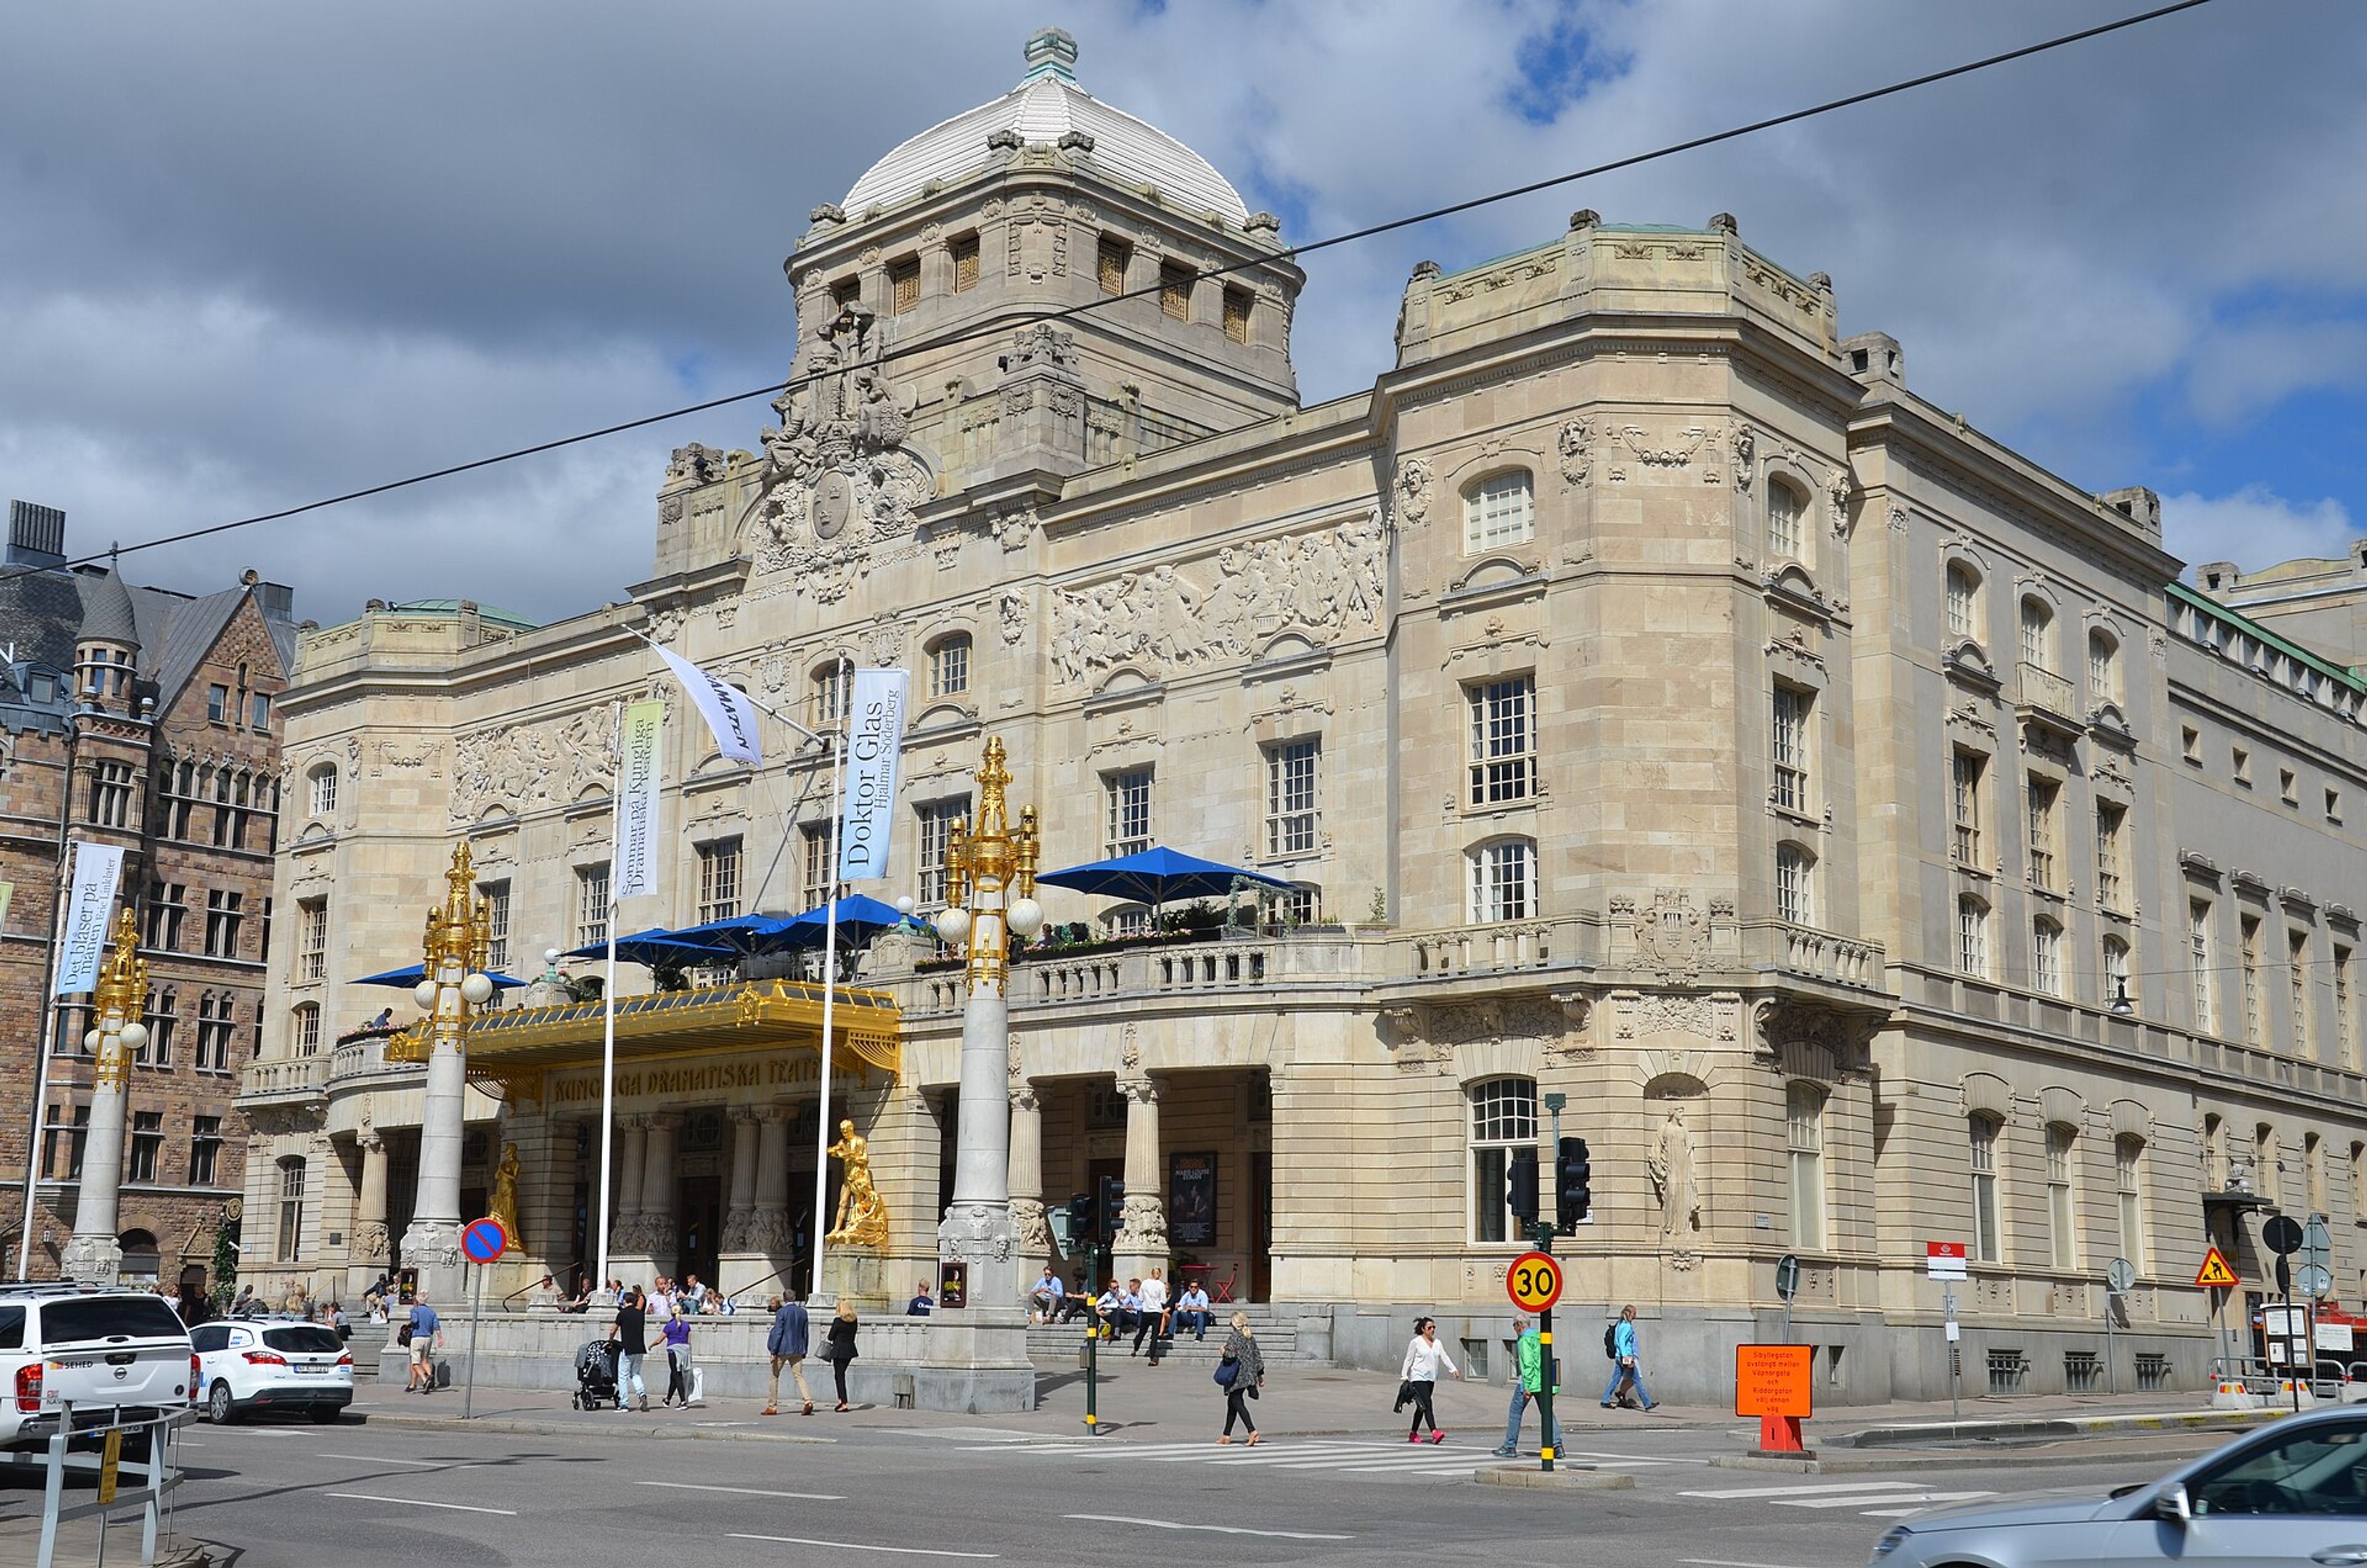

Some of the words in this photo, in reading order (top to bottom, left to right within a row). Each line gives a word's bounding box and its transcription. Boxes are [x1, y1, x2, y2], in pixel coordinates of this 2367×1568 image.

[855, 702, 883, 762] Glas
[880, 688, 899, 754] Söderberg
[629, 718, 645, 795] Kungliga
[631, 791, 648, 889] Dramatiska
[640, 721, 654, 782] Teatern
[874, 758, 891, 809] Hjalmar
[629, 799, 640, 822] på
[848, 770, 875, 867] Doktor
[101, 857, 116, 900] Linklater
[623, 826, 639, 894] Sommar
[80, 883, 98, 902] på
[96, 901, 108, 920] Eric
[70, 906, 93, 955] blåser
[64, 958, 82, 986] Det
[555, 1073, 642, 1102] KUNGIGA
[647, 1063, 760, 1095] DRAMATISKA
[1516, 1268, 1554, 1297] 30
[65, 1361, 94, 1369] SEHED
